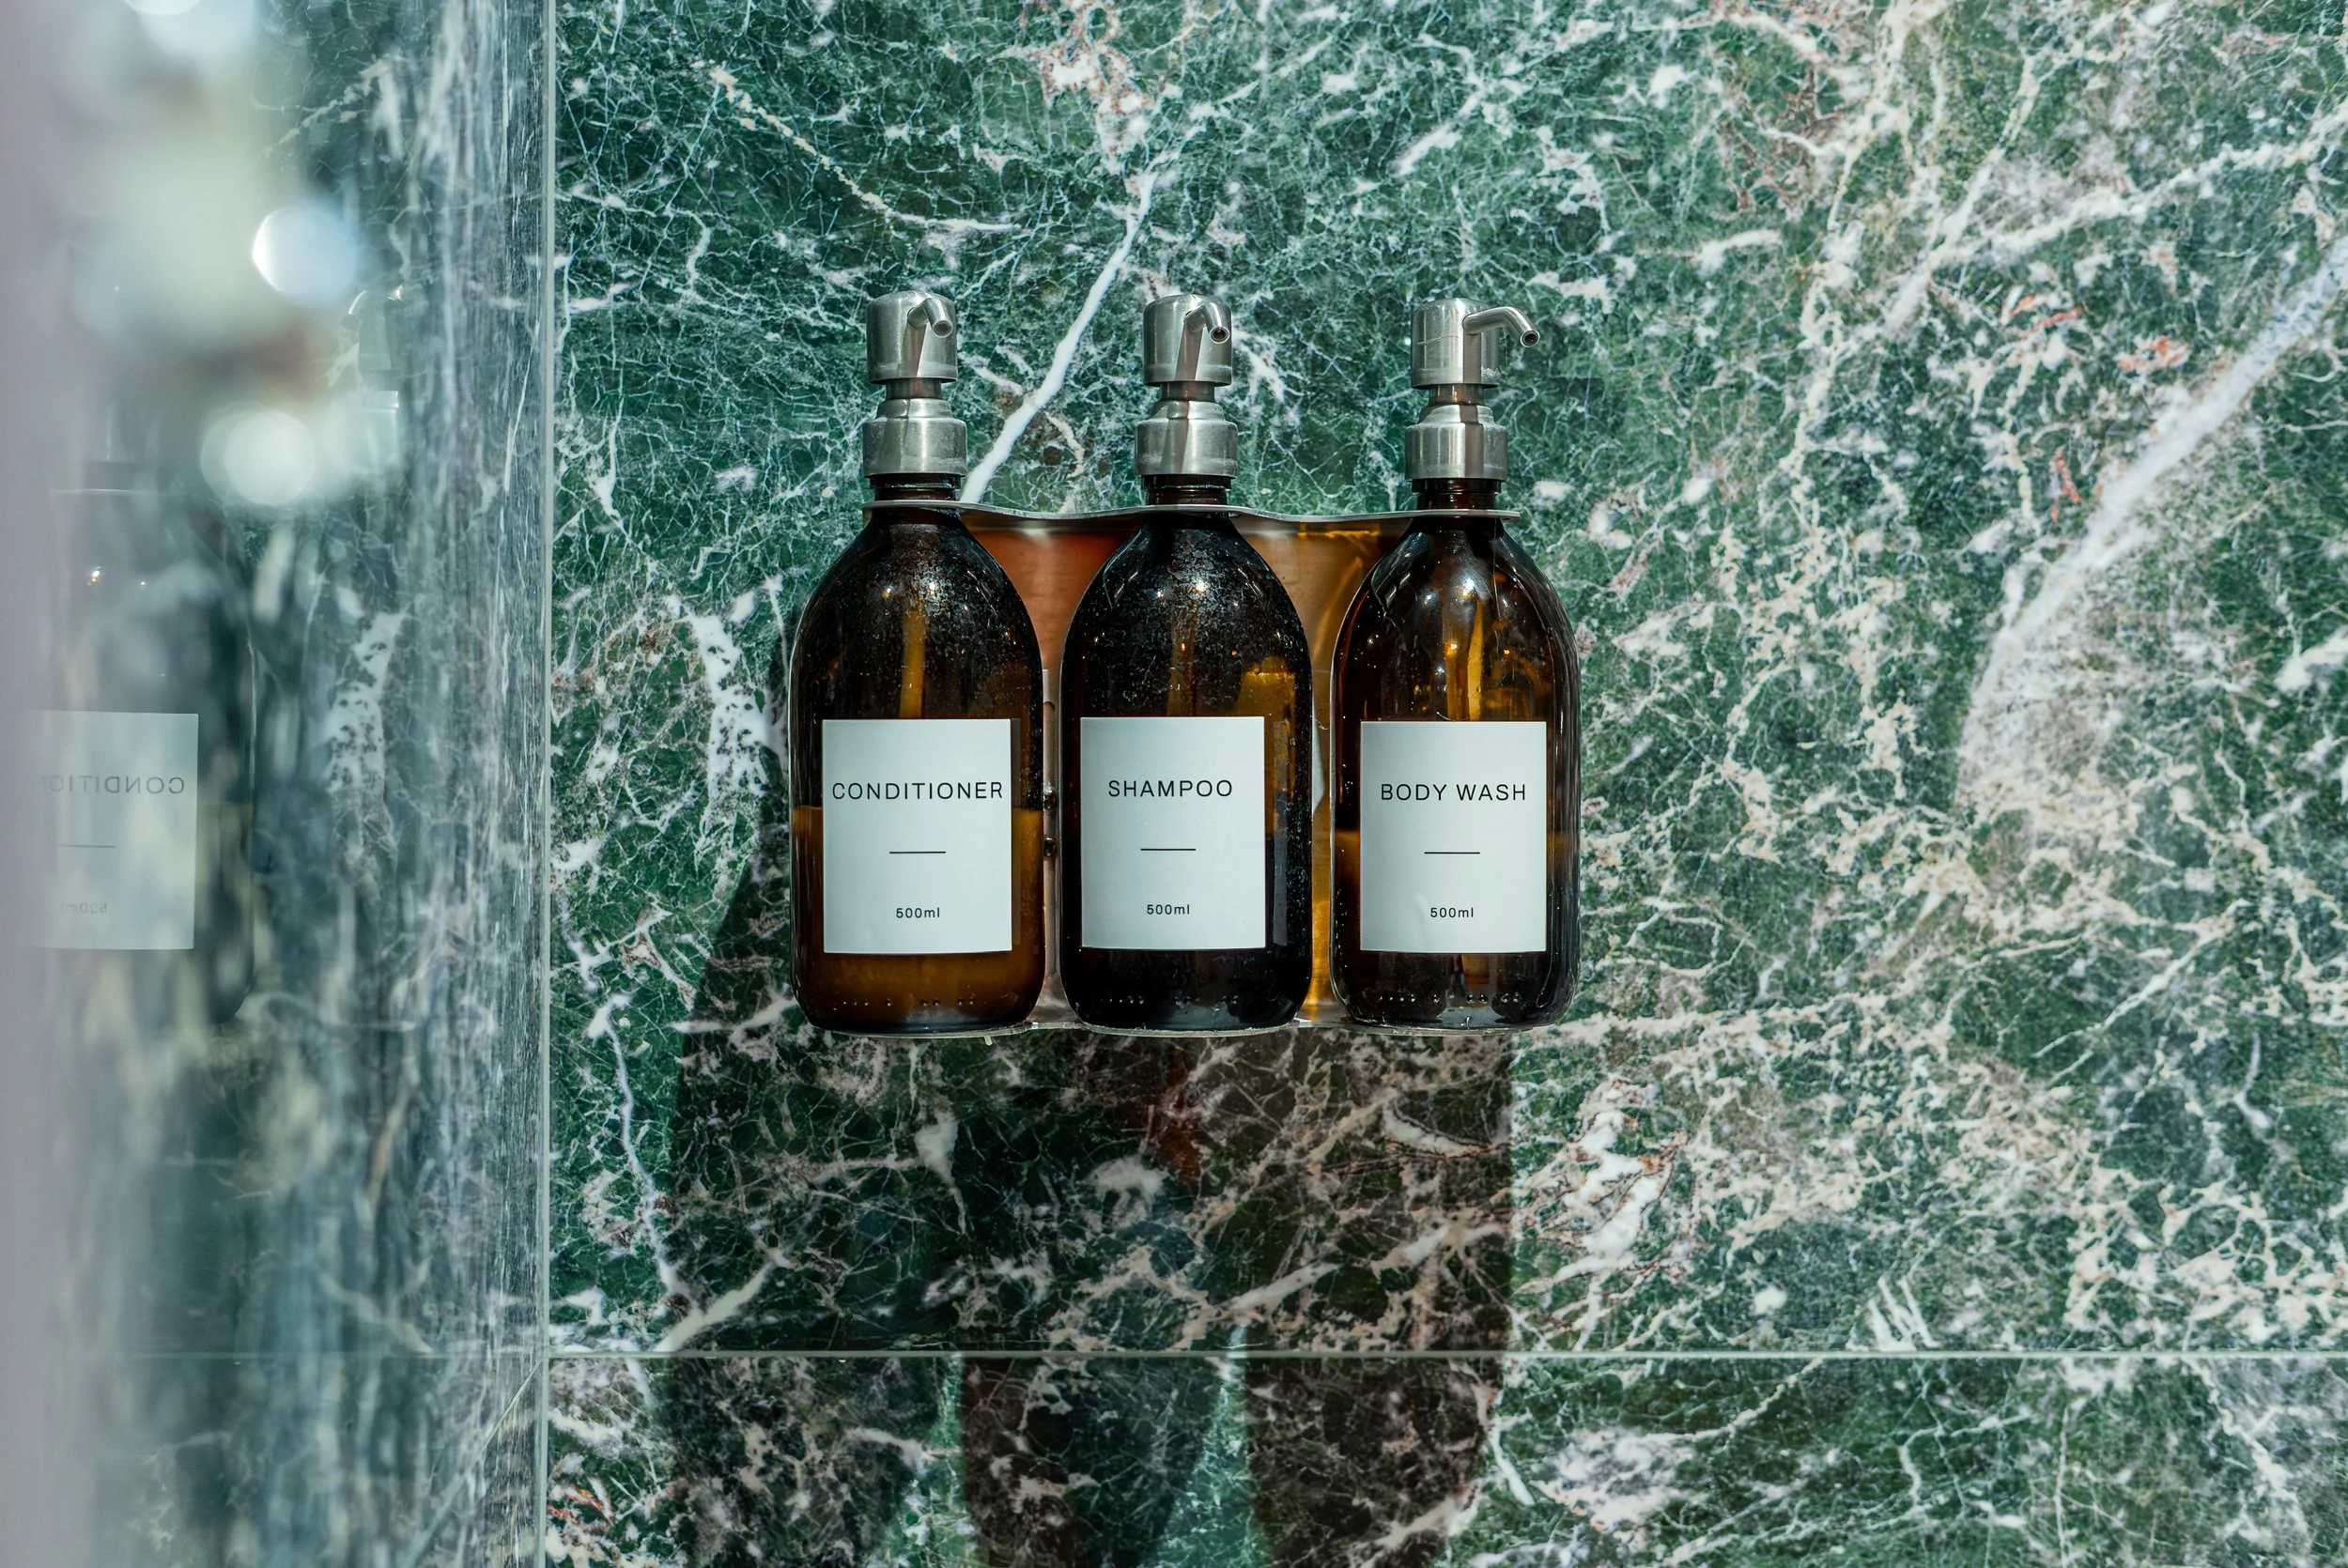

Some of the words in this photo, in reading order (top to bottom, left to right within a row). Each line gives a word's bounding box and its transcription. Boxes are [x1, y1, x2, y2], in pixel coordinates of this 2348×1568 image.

[831, 781, 1003, 801] CONDITIONER
[1108, 779, 1232, 797] SHAMPOO
[1381, 783, 1447, 802] BODY
[1456, 783, 1525, 802] WASH
[895, 907, 940, 919] 500ml
[1146, 903, 1190, 915] 500ml
[1429, 906, 1474, 918] 500ml
